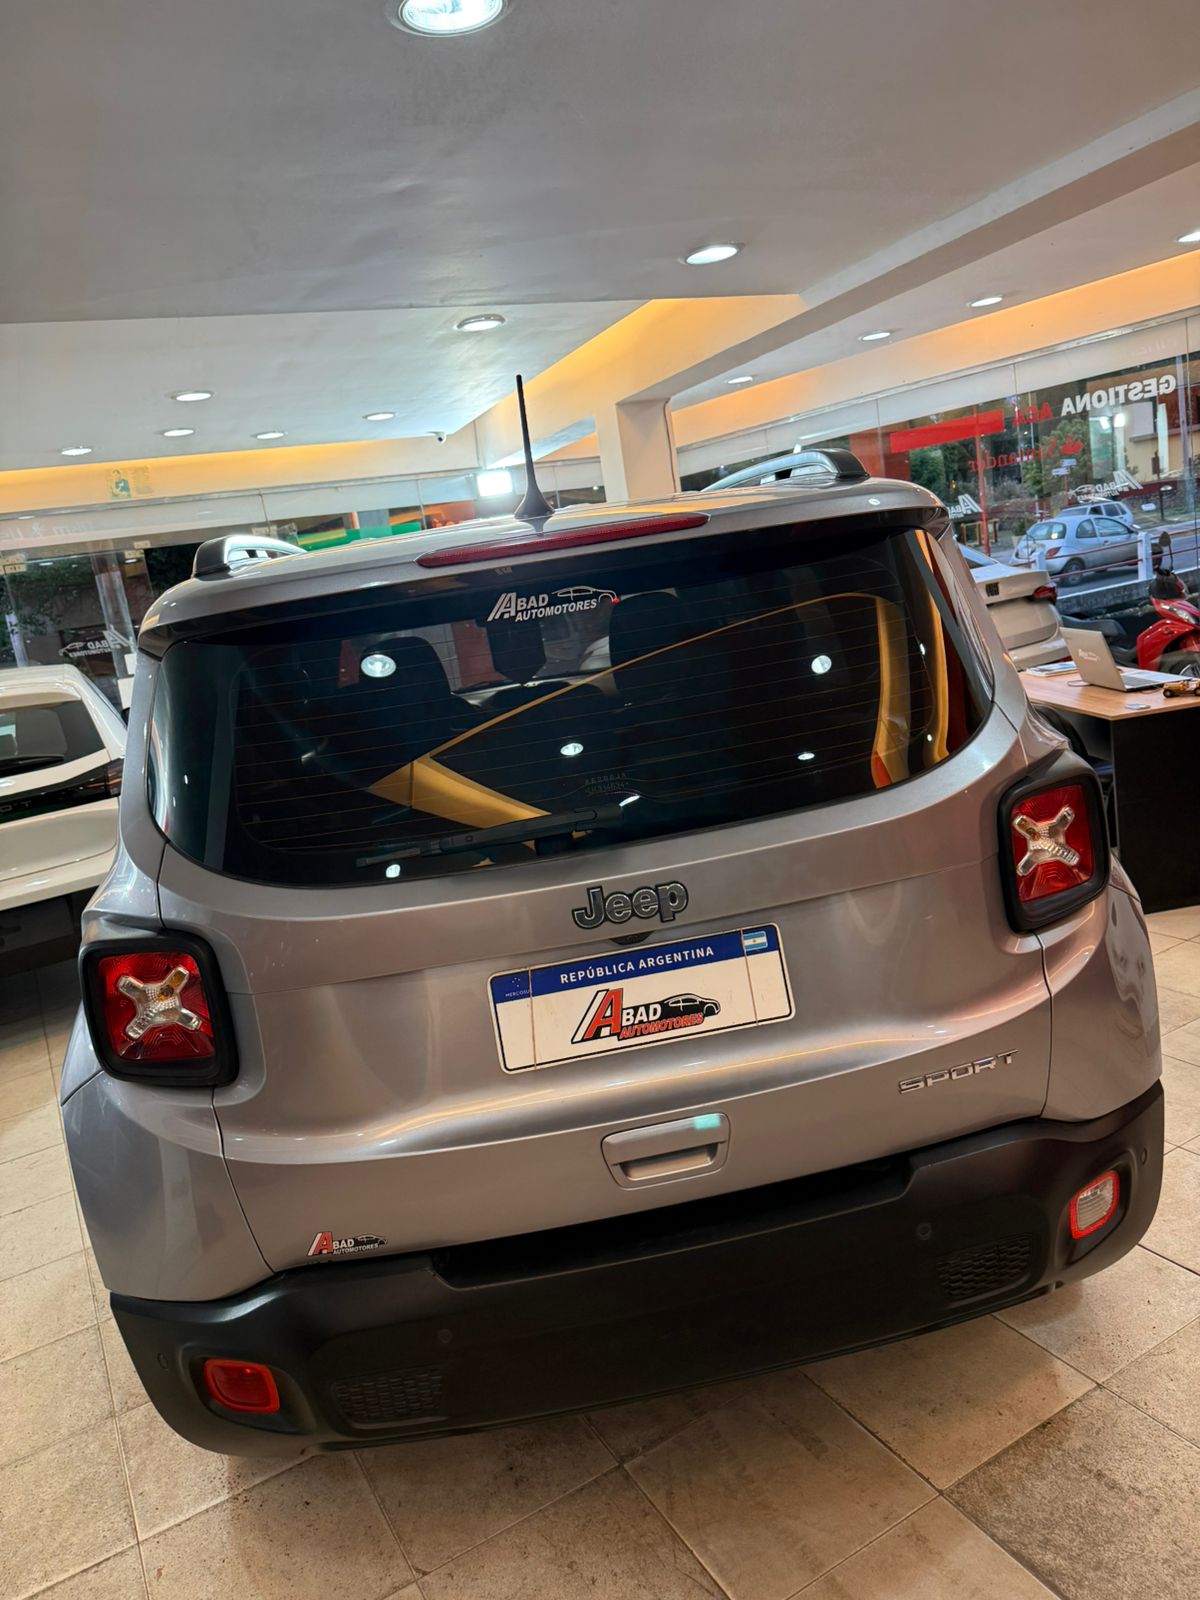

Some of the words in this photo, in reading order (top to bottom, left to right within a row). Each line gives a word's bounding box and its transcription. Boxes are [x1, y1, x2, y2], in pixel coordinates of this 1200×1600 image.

[487, 592, 549, 622] ABAD
[515, 599, 597, 622] AUTOMOTORES
[572, 881, 689, 929] Jeep
[560, 961, 635, 984] REPÚBLICA
[638, 946, 714, 969] ARGENTINA
[571, 988, 662, 1044] ABAD
[619, 1013, 704, 1040] AUTOMOTORES
[898, 1048, 1019, 1094] SPORT
[307, 1231, 355, 1256] ABAD
[333, 1243, 379, 1255] AUTOMOTORES
